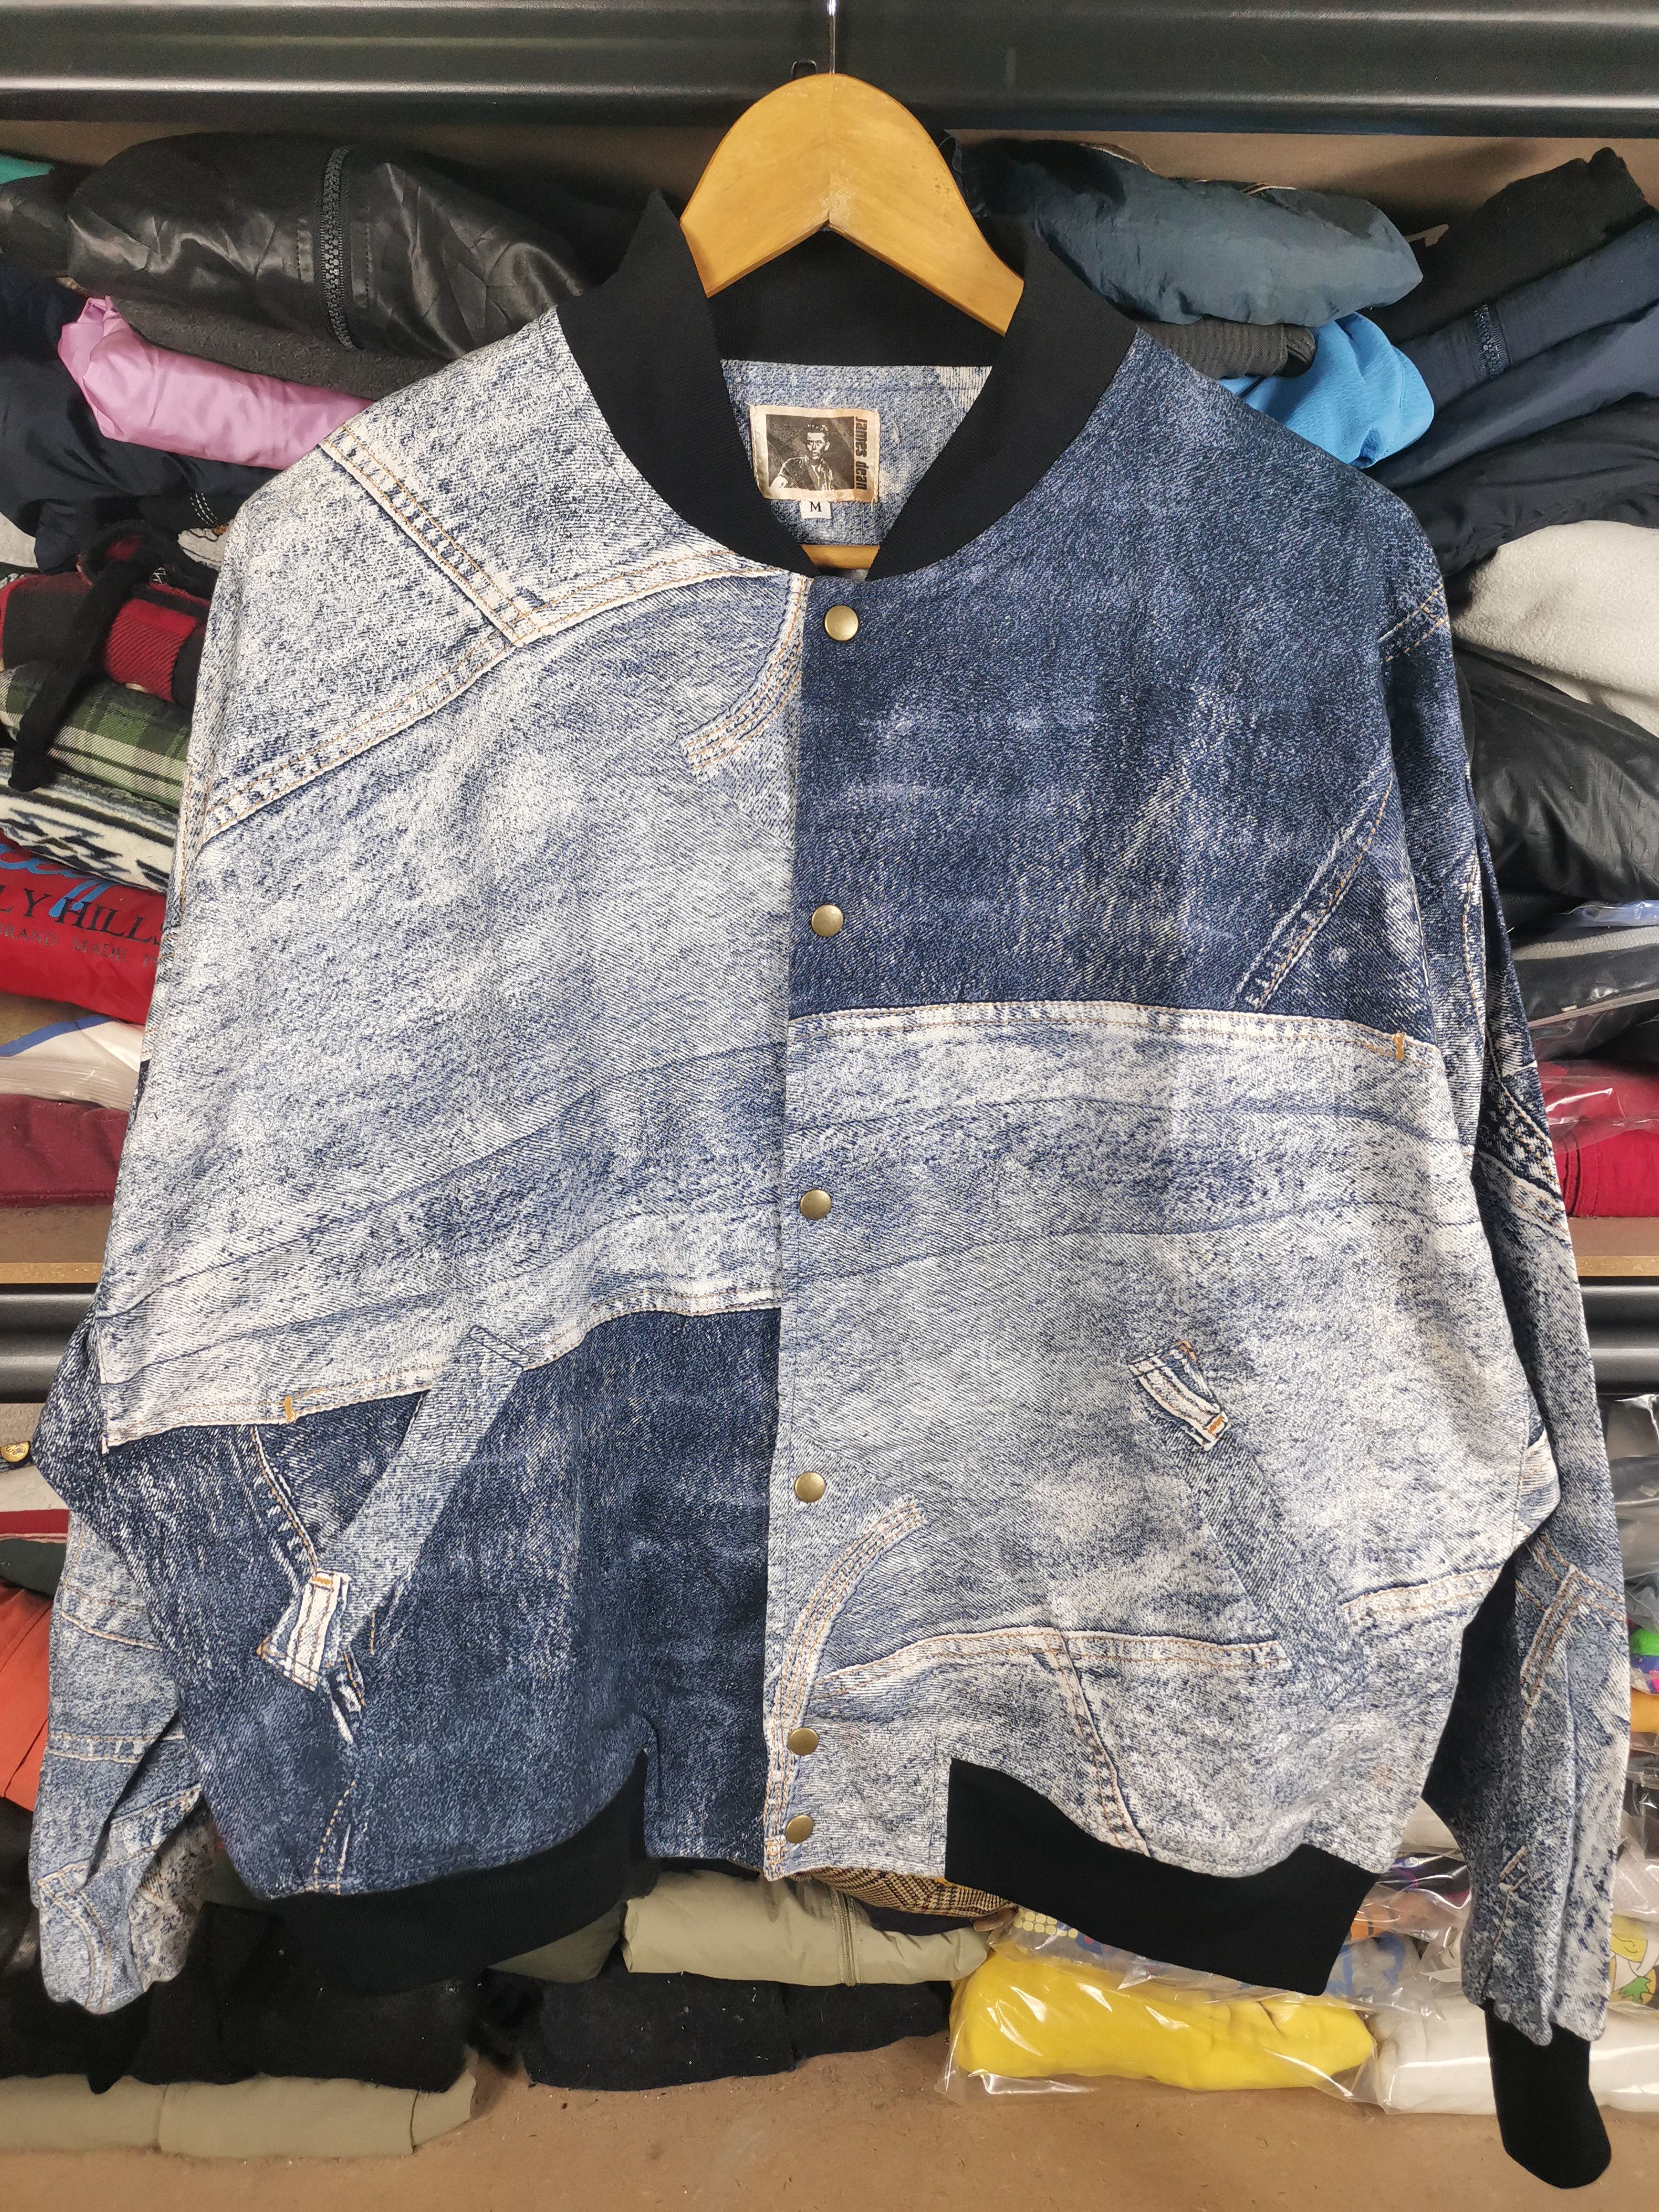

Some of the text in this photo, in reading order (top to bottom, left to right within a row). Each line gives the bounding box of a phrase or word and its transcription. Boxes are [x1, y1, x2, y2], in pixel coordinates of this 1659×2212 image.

[809, 500, 822, 512] M
[55, 896, 164, 946] HILL
[0, 922, 58, 946] RAND
